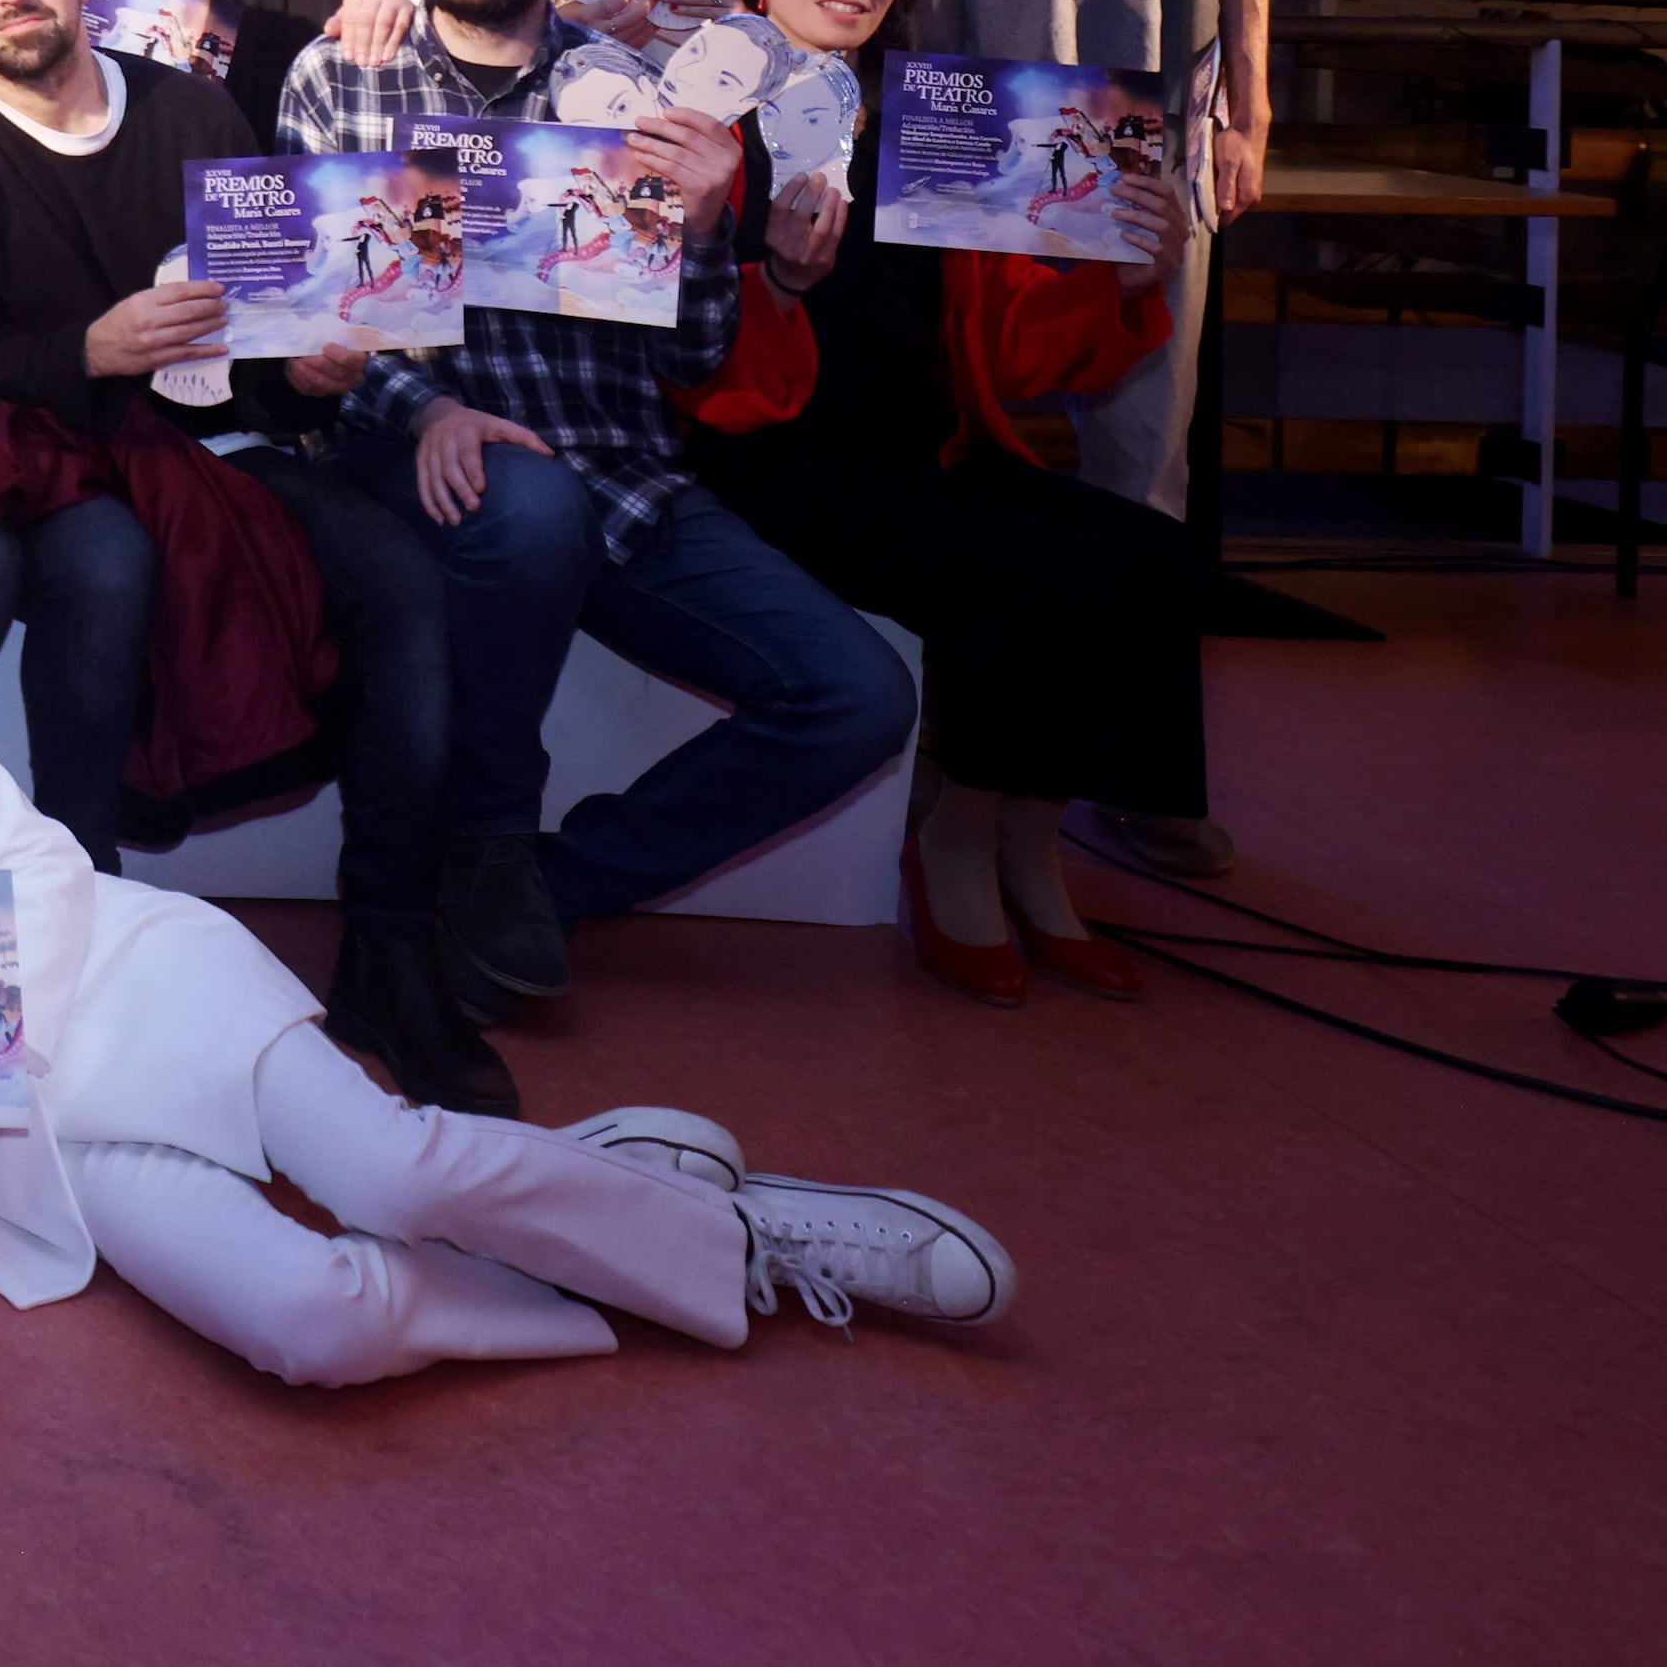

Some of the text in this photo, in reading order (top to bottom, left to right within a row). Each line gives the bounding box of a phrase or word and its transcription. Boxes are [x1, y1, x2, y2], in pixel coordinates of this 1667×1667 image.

[904, 69, 984, 89] PREMIOS
[917, 85, 993, 105] TEATRO
[931, 101, 998, 116] María Casares
[411, 131, 494, 150] PREMIOS
[204, 174, 285, 193] PREMIOS
[219, 190, 296, 208] TEATRO
